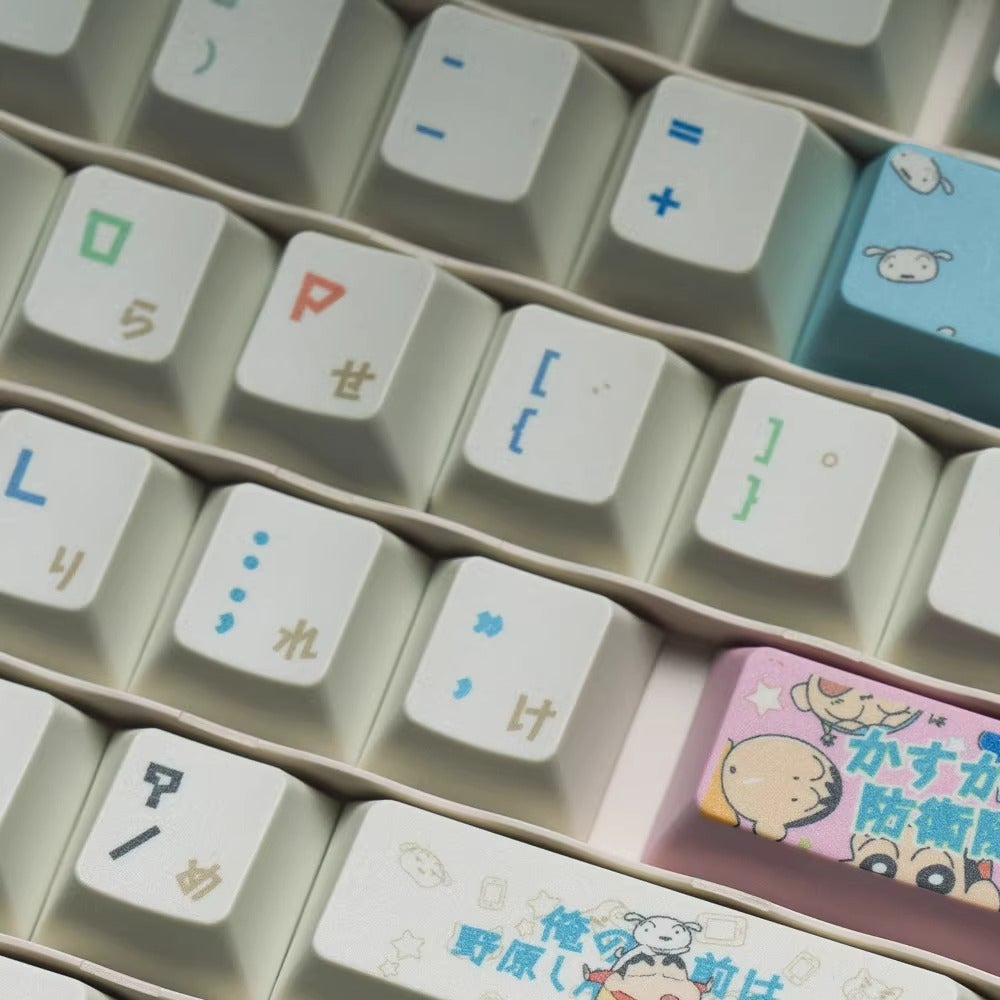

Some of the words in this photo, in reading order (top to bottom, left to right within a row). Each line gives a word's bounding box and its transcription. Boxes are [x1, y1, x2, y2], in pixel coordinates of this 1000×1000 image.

[120, 298, 159, 340] ら
[289, 271, 348, 322] P
[330, 359, 377, 402] せ
[4, 447, 48, 507] L
[49, 545, 86, 592] り
[272, 618, 319, 661] れ
[506, 694, 557, 741] け
[143, 761, 184, 809] ?
[175, 857, 223, 903] め
